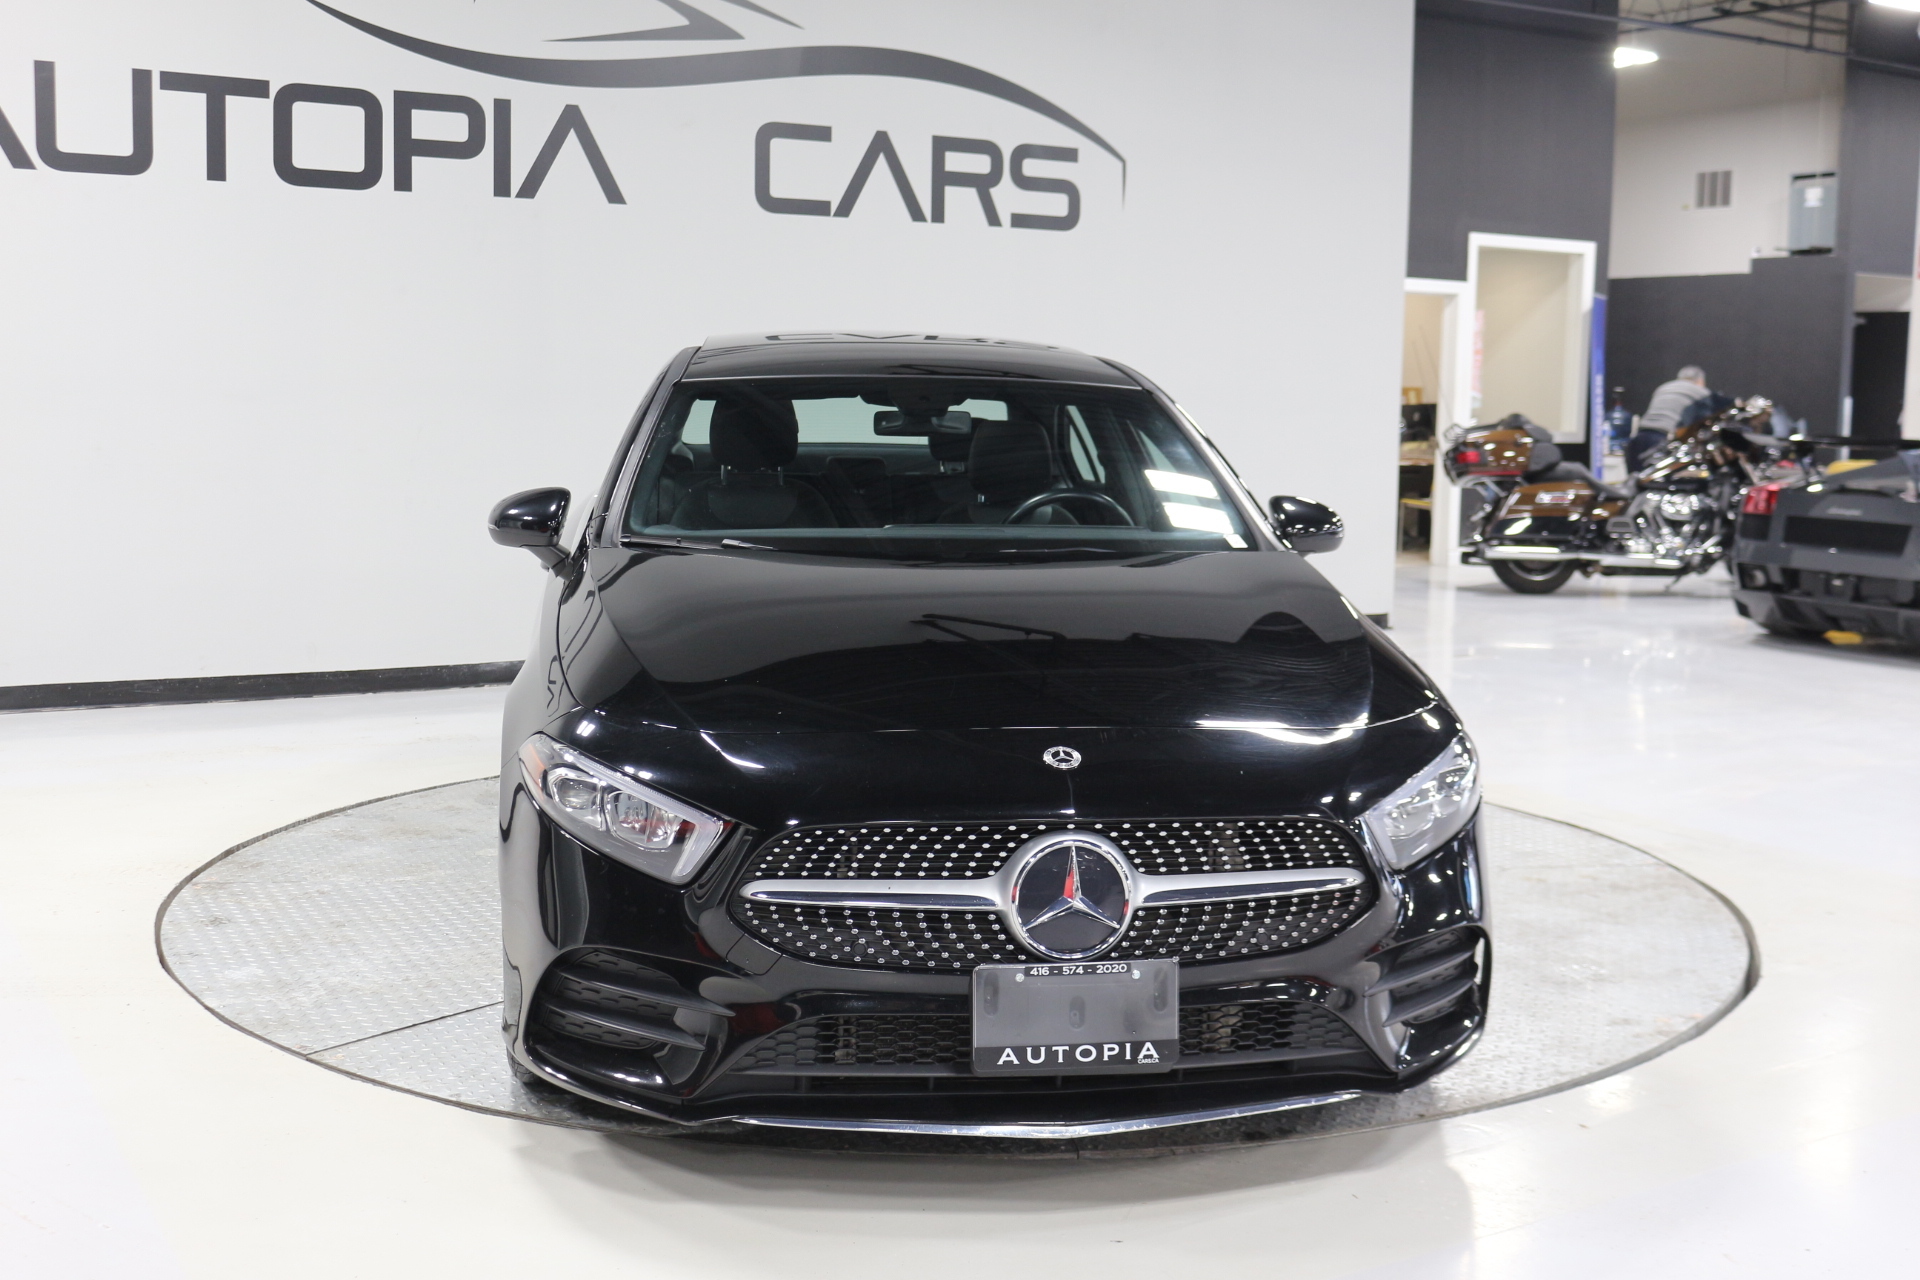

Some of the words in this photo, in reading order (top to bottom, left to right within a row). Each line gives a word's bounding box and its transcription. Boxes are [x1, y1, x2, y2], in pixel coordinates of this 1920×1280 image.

[755, 121, 1081, 231] CARS
[1030, 967, 1050, 976] 416
[1062, 966, 1084, 975] 574
[1096, 964, 1127, 974] 2020
[997, 1042, 1160, 1065] AUTOPIA
